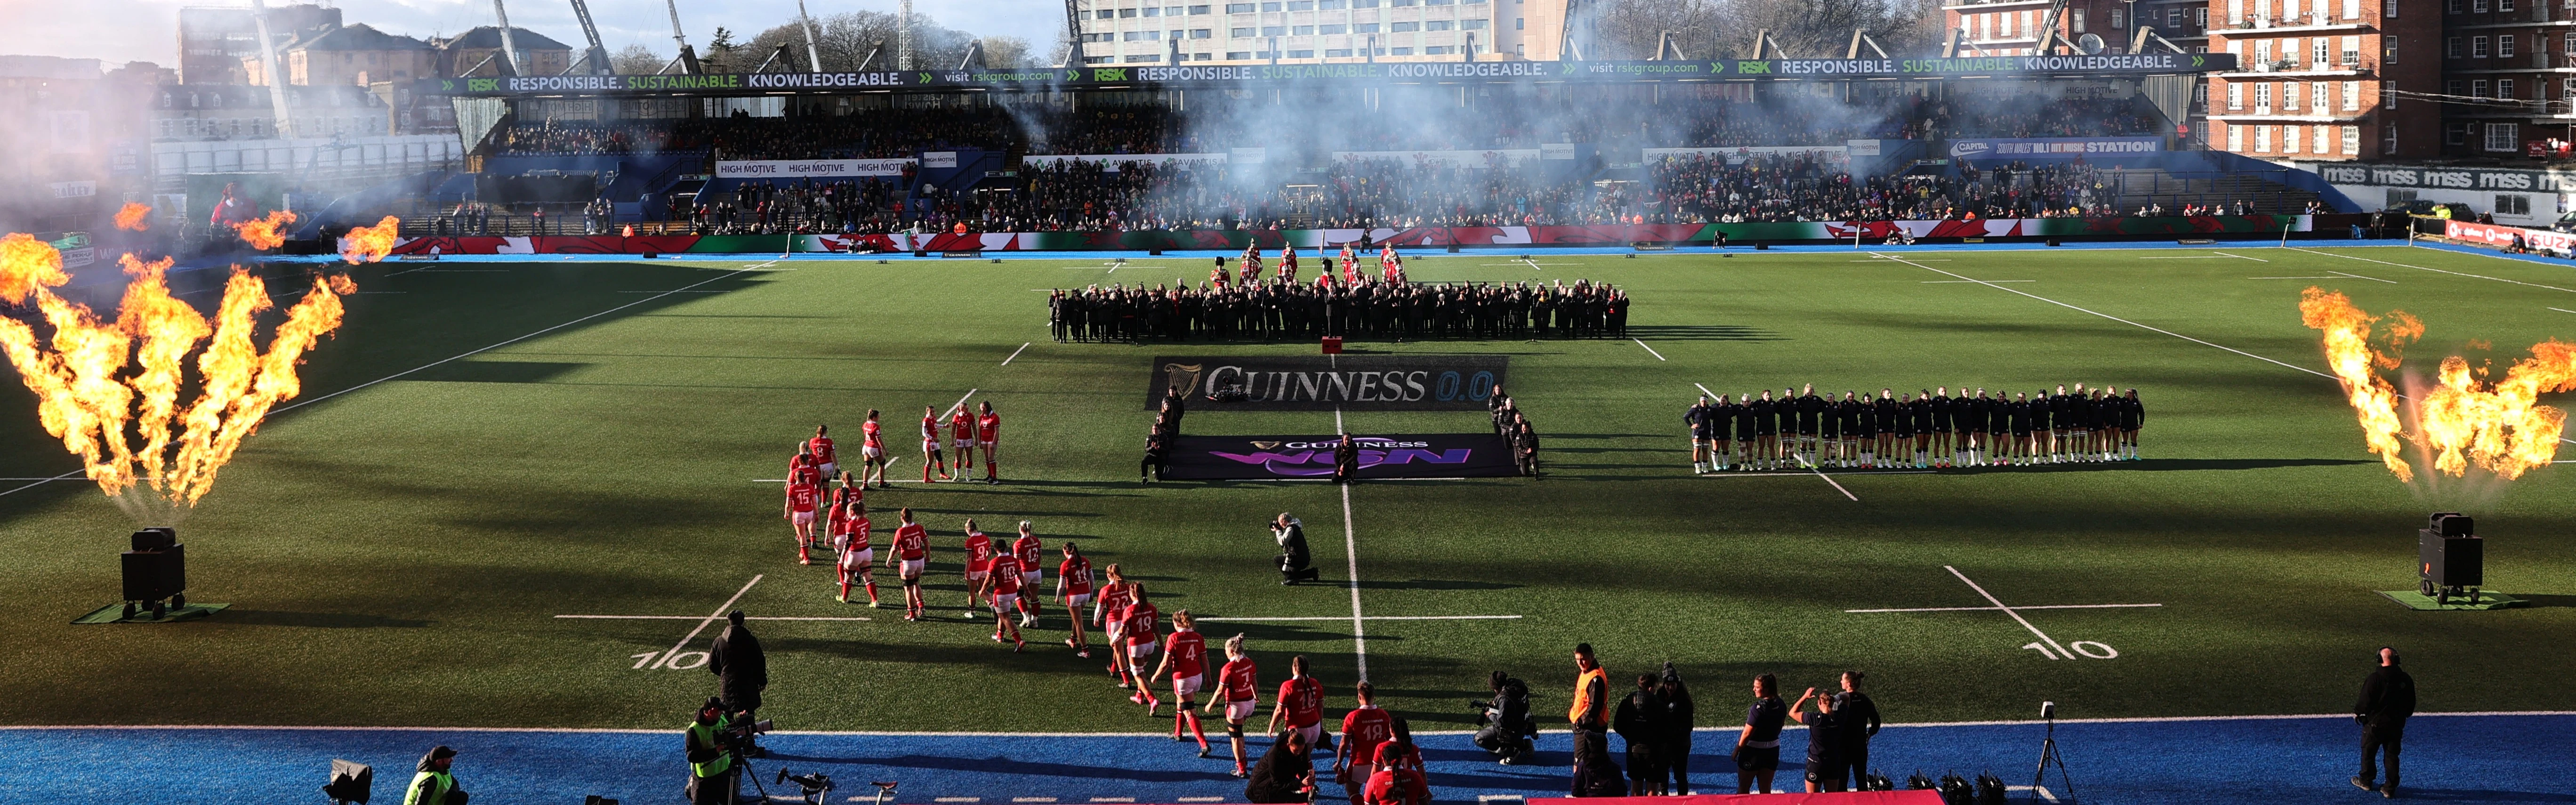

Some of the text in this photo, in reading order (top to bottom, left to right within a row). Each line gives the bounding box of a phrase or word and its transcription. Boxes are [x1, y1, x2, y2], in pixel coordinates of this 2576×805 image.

[1138, 63, 1547, 80] RESPONSIBLE. SUSTAINABLE. KNOWLEDGEABLE.
[1589, 63, 1698, 75] visit rskgroup.com
[1739, 61, 1771, 73] RSK
[1782, 56, 2177, 73] RESPONSIBLE. SUSTAINABLE. KNOWLEDGEABLE.
[509, 72, 903, 90] RESPONSIBLE. SUSTAINABLE. KNOWLEDGEABLE.
[945, 71, 1054, 84] visit rskgroup.com
[1094, 68, 1127, 81] RSK
[468, 79, 499, 91] RSK
[1959, 143, 1989, 151] CAPITAL
[1997, 144, 2013, 154] SOUTH
[2034, 143, 2049, 153] NO.1
[2051, 144, 2062, 153] HIT
[2064, 143, 2084, 152] MUSIC
[2087, 142, 2157, 153] STATION
[744, 165, 776, 173] MOTIVE
[789, 164, 844, 172] HIGH MOTIVE
[881, 163, 904, 171] MOTI
[2323, 167, 2366, 183] mss
[2373, 169, 2418, 185] mss
[2424, 171, 2472, 187] mss
[2479, 173, 2531, 189] mss
[2527, 234, 2576, 249] ISUZ
[1206, 366, 1494, 402] GUINNESS 0.0
[817, 447, 823, 457] 8
[797, 492, 809, 504] 15
[859, 527, 866, 540] 5
[905, 535, 921, 550] 20
[978, 546, 985, 559] 9
[1026, 547, 1038, 563] 12
[1001, 565, 1015, 580] 10
[1075, 566, 1087, 582] 11
[1112, 596, 1128, 611] 22
[1136, 616, 1151, 632] 19
[1186, 644, 1196, 660] 4
[2022, 641, 2118, 660] 10
[630, 651, 710, 669] 10
[1241, 671, 1250, 687] 7
[1363, 724, 1383, 741] 18
